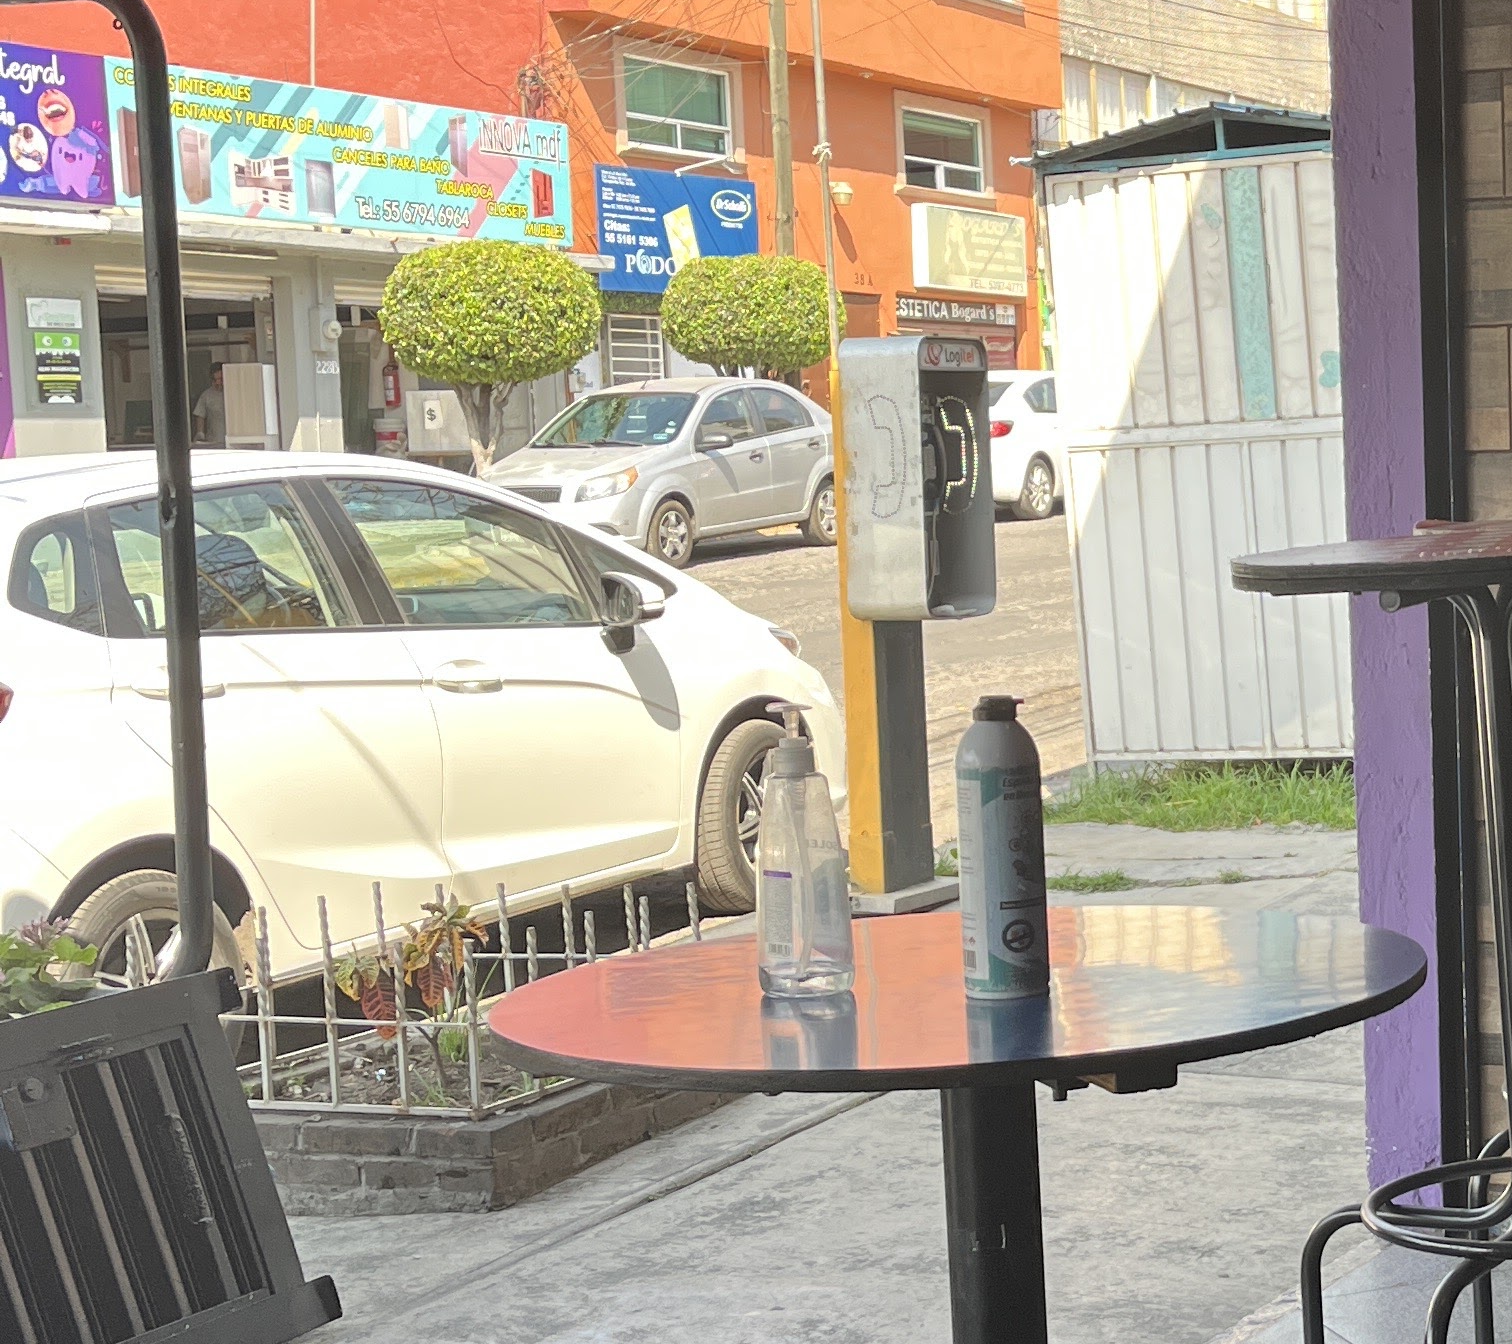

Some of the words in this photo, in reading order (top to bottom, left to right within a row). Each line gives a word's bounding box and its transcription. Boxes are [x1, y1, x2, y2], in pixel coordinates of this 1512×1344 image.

[178, 76, 251, 102] INTEGRALES
[236, 110, 243, 125] Y
[245, 111, 295, 132] PUERTAS
[298, 117, 314, 134] DE
[315, 119, 373, 142] ALUMINIO
[332, 147, 388, 168] CANCELES
[390, 154, 416, 173] PARA
[418, 156, 450, 176] BAÑO
[536, 125, 562, 172] mdf
[435, 178, 493, 199] TABLAROCA
[382, 200, 400, 222] 55
[402, 202, 435, 224] 6794
[437, 204, 470, 228] 6964
[486, 201, 528, 220] CLOSETS
[524, 222, 566, 239] MUEBLES
[943, 344, 976, 367] Logitel
